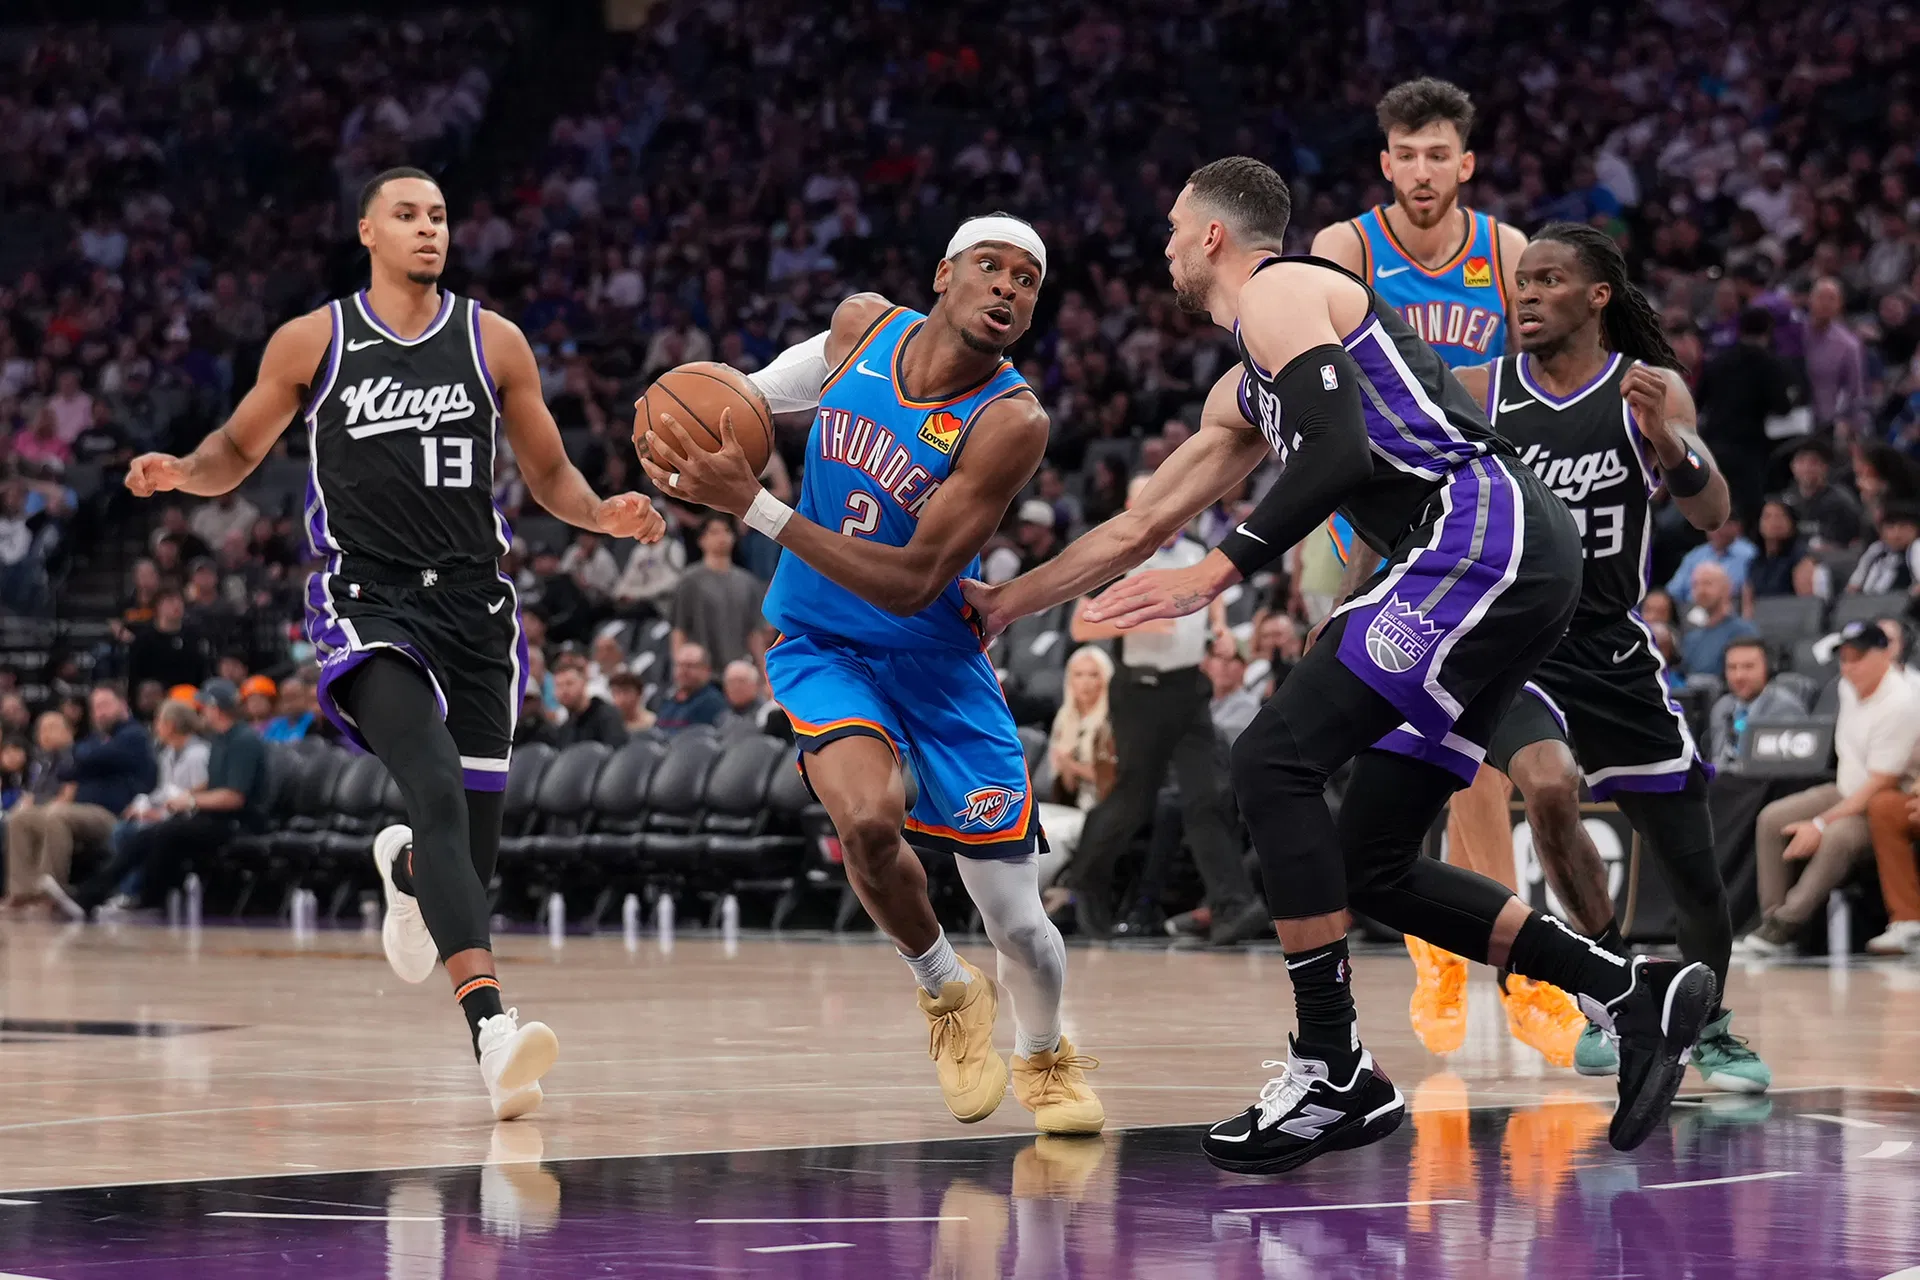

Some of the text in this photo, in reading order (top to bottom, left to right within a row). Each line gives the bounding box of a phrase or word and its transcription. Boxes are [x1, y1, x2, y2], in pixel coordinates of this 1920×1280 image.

[1394, 300, 1500, 354] UNDER
[340, 376, 476, 440] Kings
[420, 437, 473, 488] 13
[841, 490, 882, 537] 2
[1569, 504, 1625, 558] 3
[1372, 617, 1425, 662] KINGS
[1383, 610, 1429, 648] SACRAMENTO
[968, 794, 1002, 821] OKC
